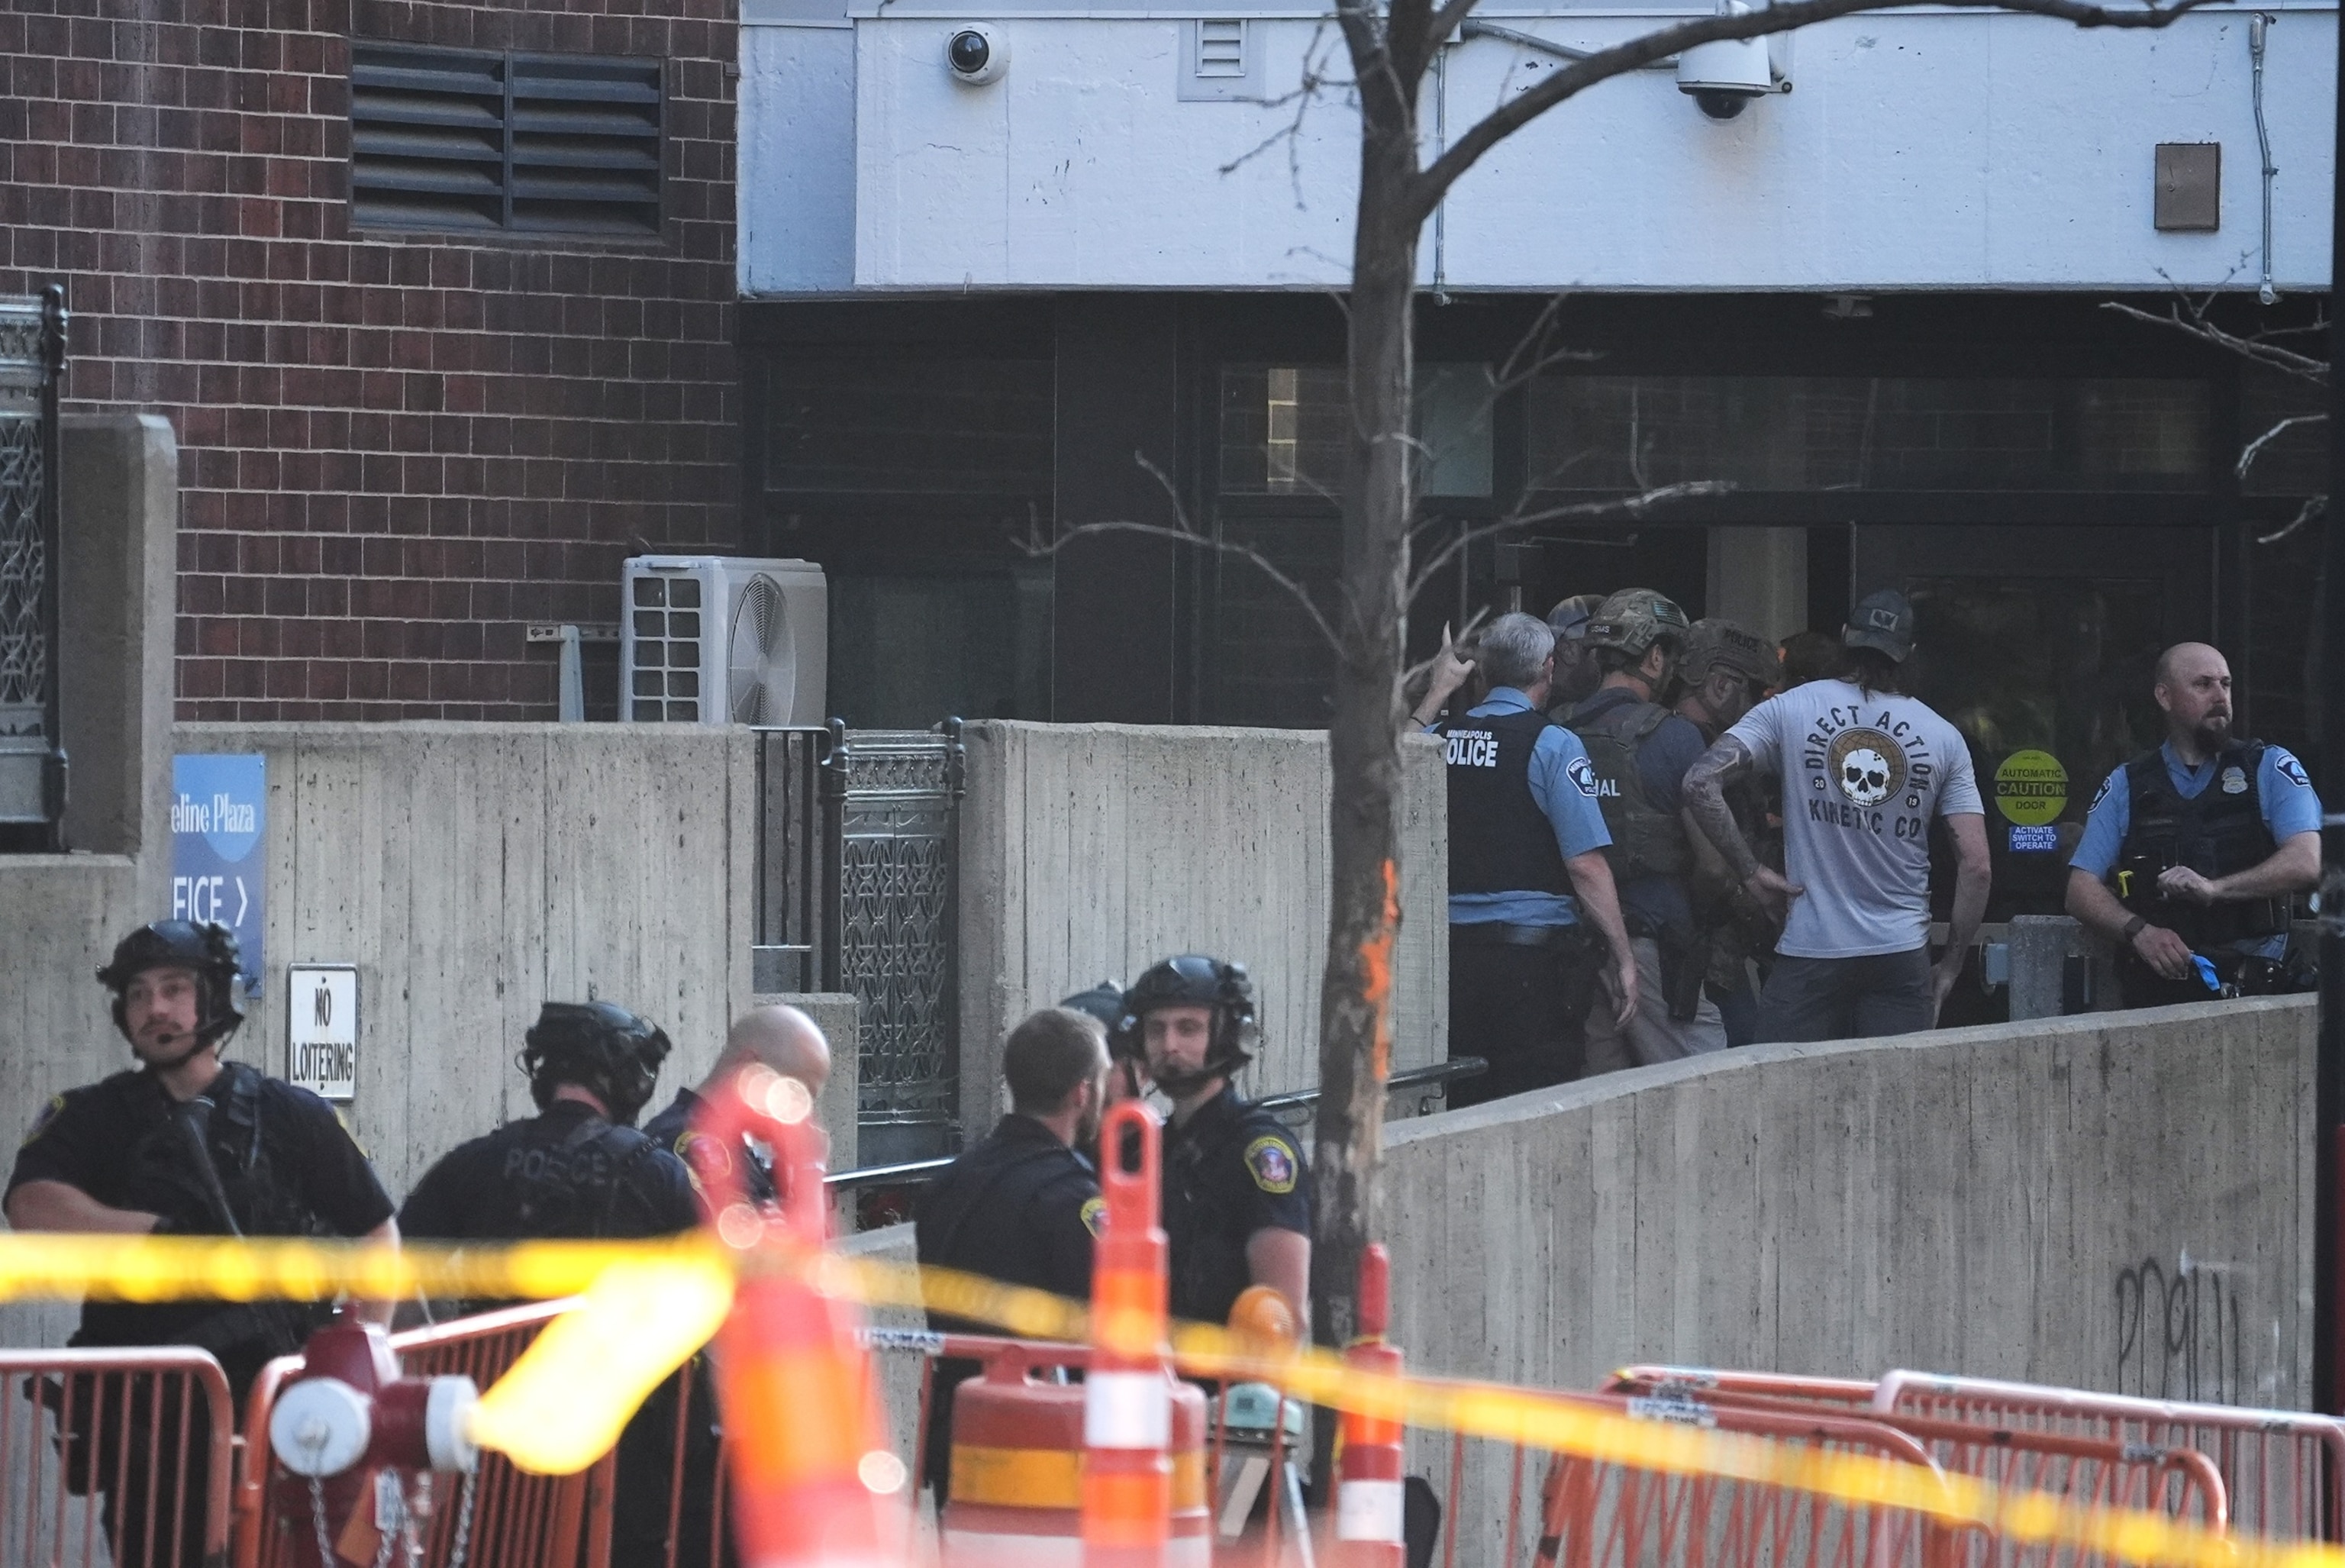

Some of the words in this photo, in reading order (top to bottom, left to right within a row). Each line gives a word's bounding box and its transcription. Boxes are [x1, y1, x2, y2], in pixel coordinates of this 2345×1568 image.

[1447, 729, 1493, 740] MINNEAPOLIS
[1446, 737, 1498, 767] OLICE
[1805, 705, 1860, 769] DIRECT
[1876, 711, 1932, 791] ACTION
[2001, 769, 2061, 778] AUTOMATIC
[1996, 782, 2066, 795] CAUTION
[170, 793, 210, 834] eline
[213, 792, 255, 833] Plaza
[2015, 801, 2047, 810] DOOR
[1808, 799, 1883, 836] KINETIC
[1895, 815, 1921, 839] CO
[2011, 834, 2043, 842] SWITCH
[2045, 834, 2057, 842] TO
[2014, 826, 2053, 834] ACTIVATE
[2014, 841, 2053, 850] OPERATE
[173, 876, 230, 929] FICE
[314, 988, 331, 1027] NO
[292, 1042, 353, 1082] LOITERING
